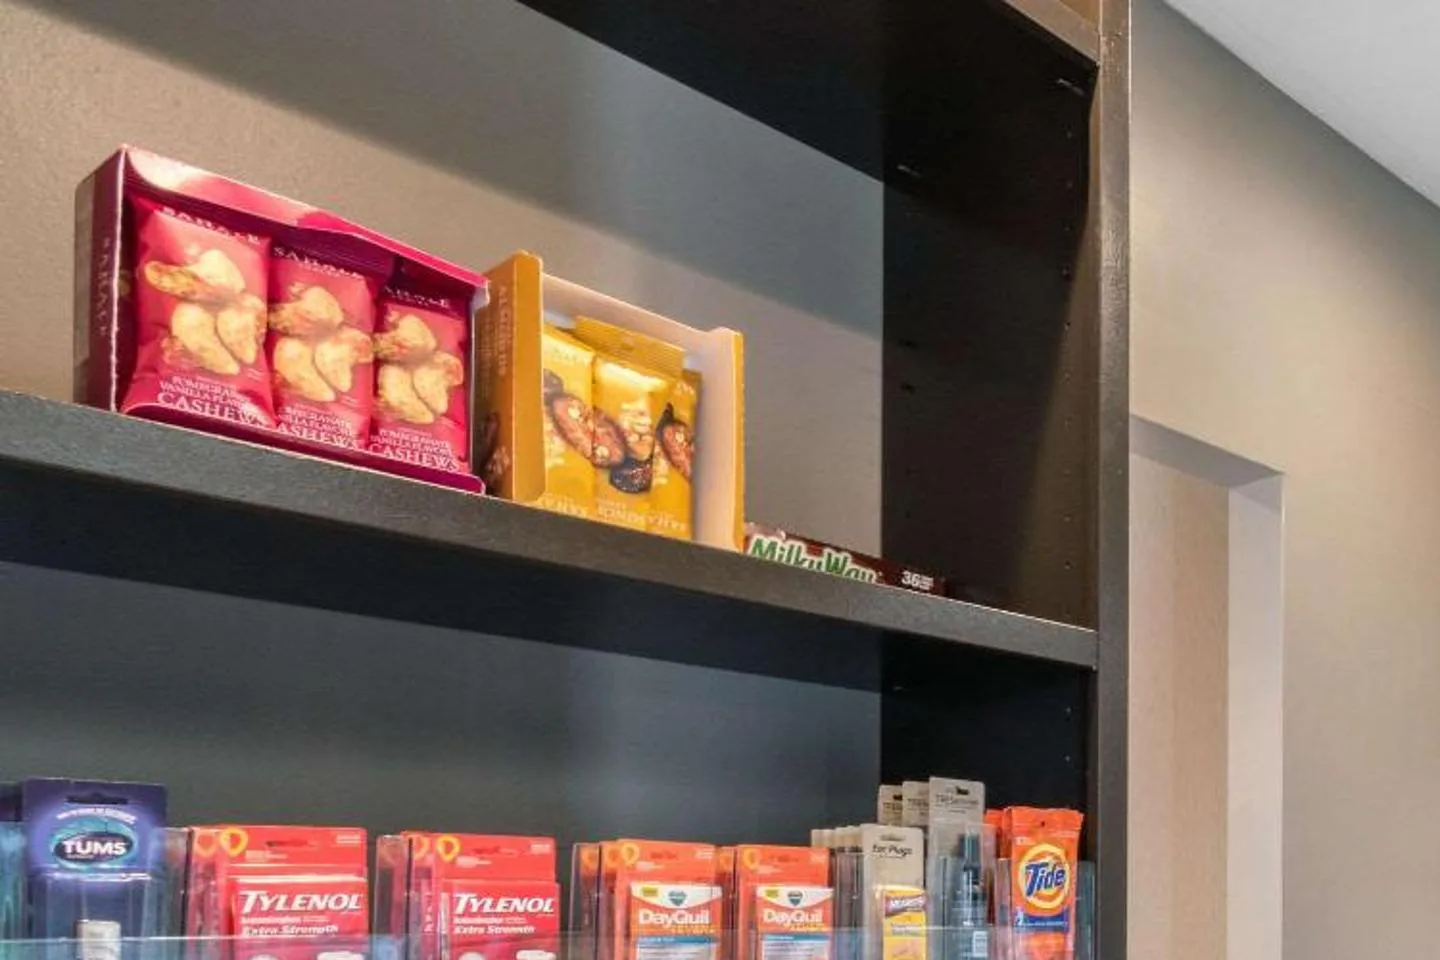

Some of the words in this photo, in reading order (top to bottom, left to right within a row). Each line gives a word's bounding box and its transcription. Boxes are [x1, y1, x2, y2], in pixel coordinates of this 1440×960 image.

[62, 840, 129, 856] TUMS
[1024, 856, 1066, 897] Tide
[239, 890, 362, 915] TYLENOL
[453, 893, 555, 915] TYLENOL
[638, 909, 711, 928] DayQuil
[762, 908, 824, 926] DayQuil
